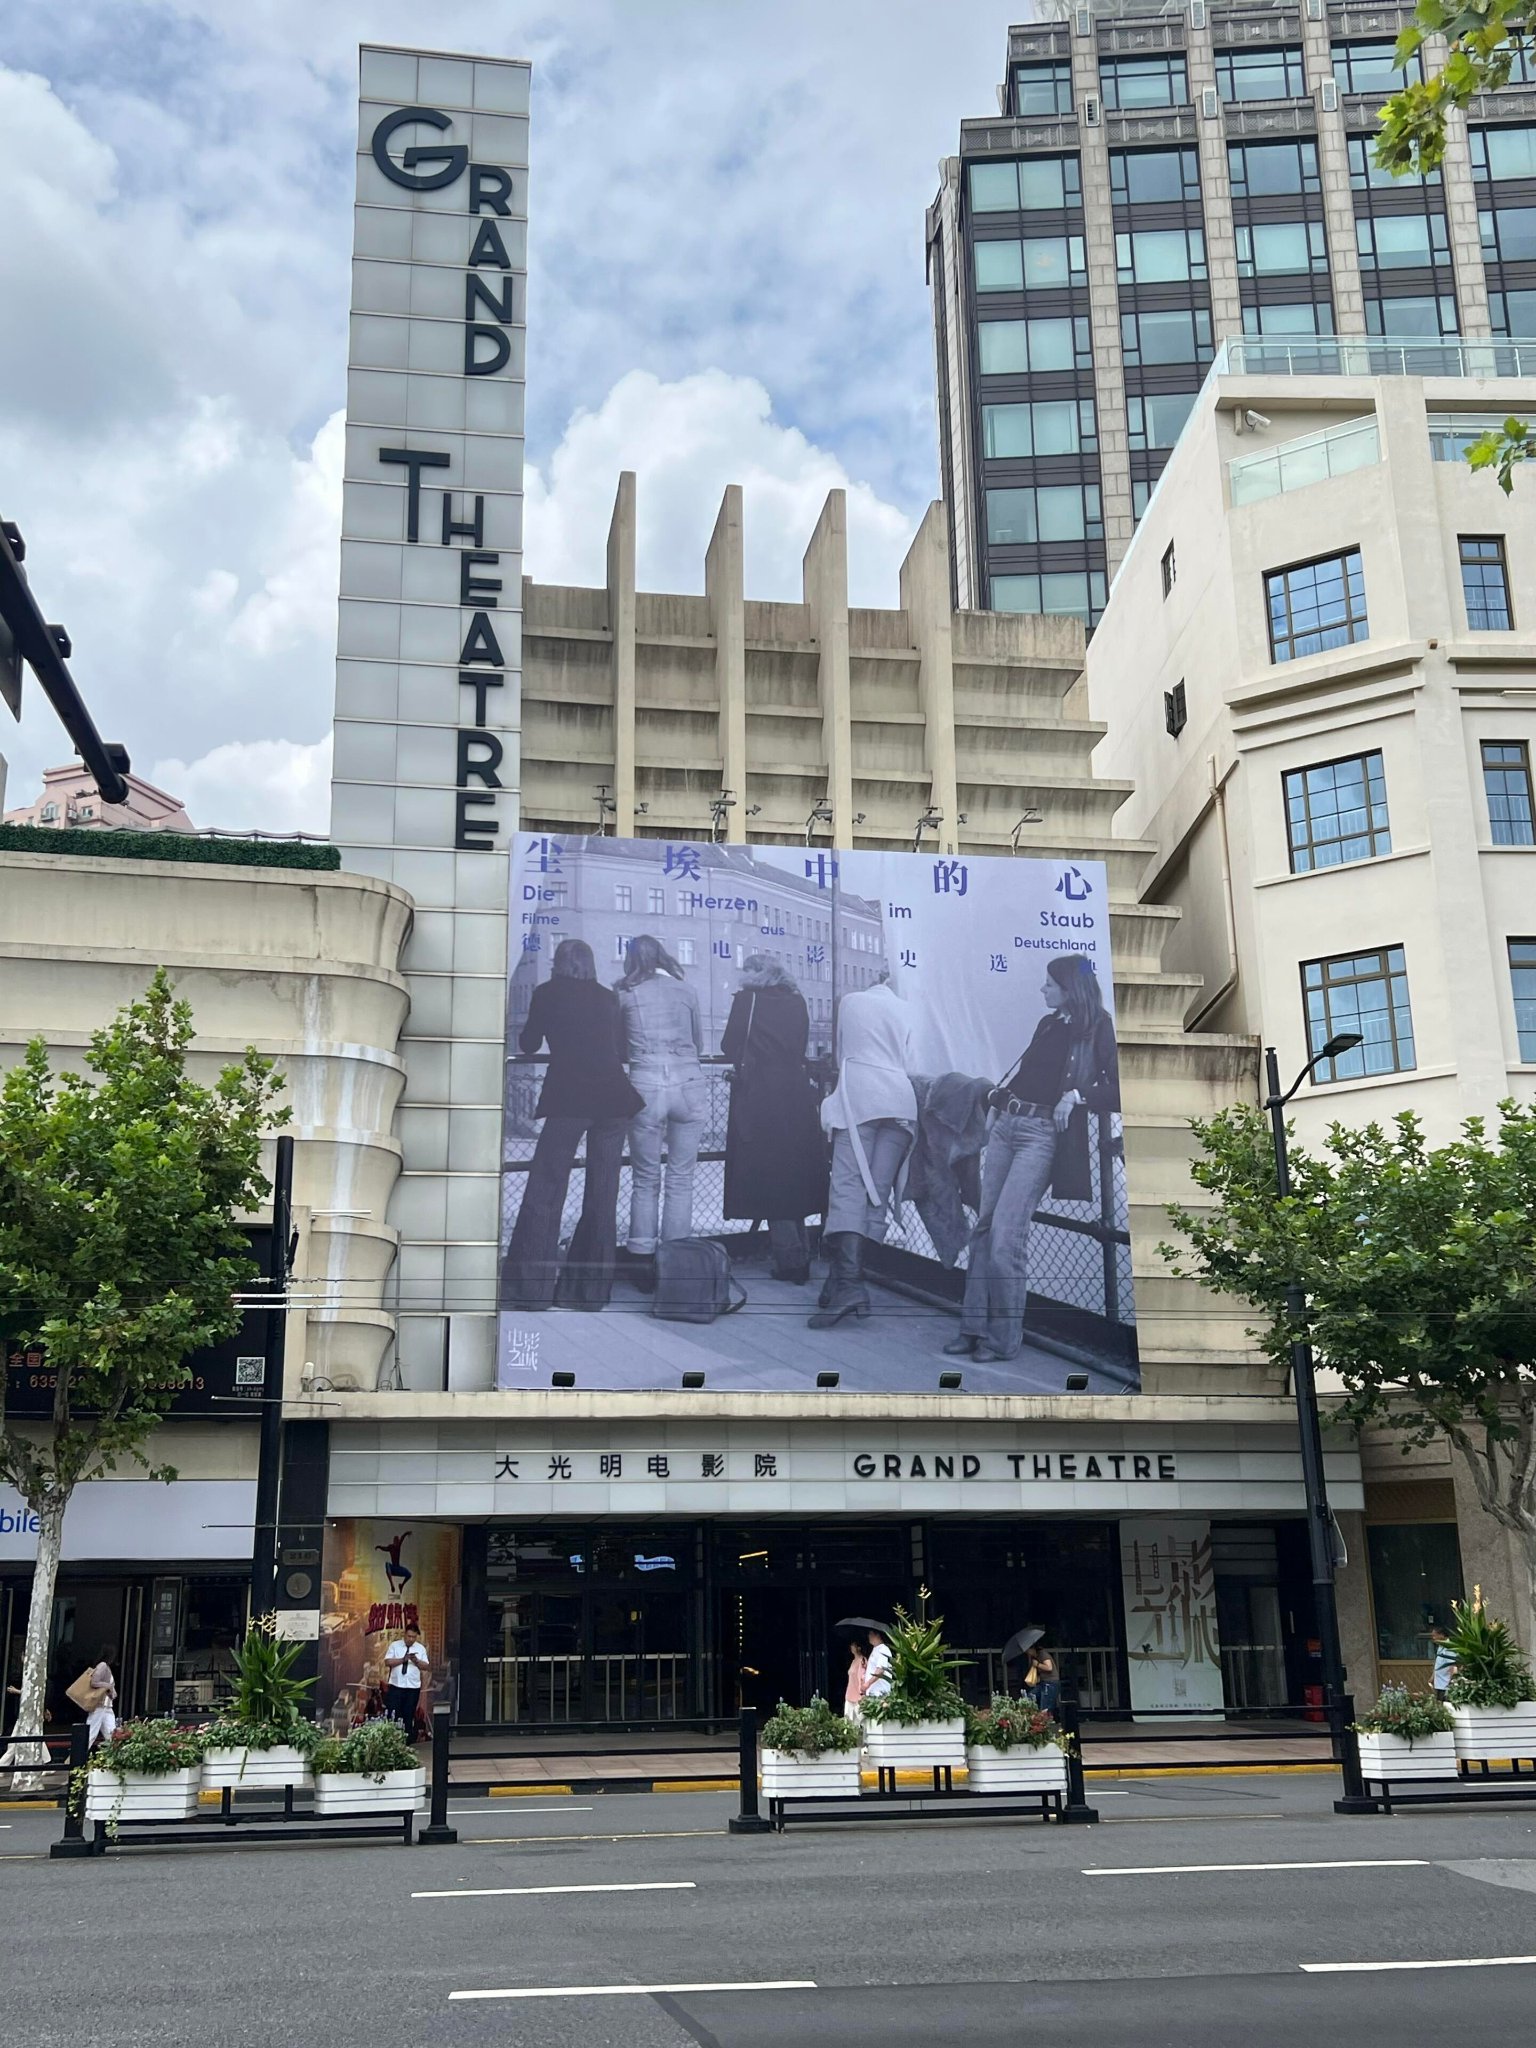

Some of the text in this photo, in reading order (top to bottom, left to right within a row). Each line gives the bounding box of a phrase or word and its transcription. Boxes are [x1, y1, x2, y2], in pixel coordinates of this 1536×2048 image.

[371, 106, 513, 376] GRAND
[378, 447, 506, 851] THEATRE
[525, 837, 1093, 901] 尘埃中的心
[523, 884, 1095, 929] Die Herzen im Staub
[522, 912, 1096, 951] Filme aus Deutschland
[495, 1454, 778, 1479] 大光明电影院
[853, 1453, 1176, 1479] GRAND THEATRE
[0, 1508, 40, 1533] bile
